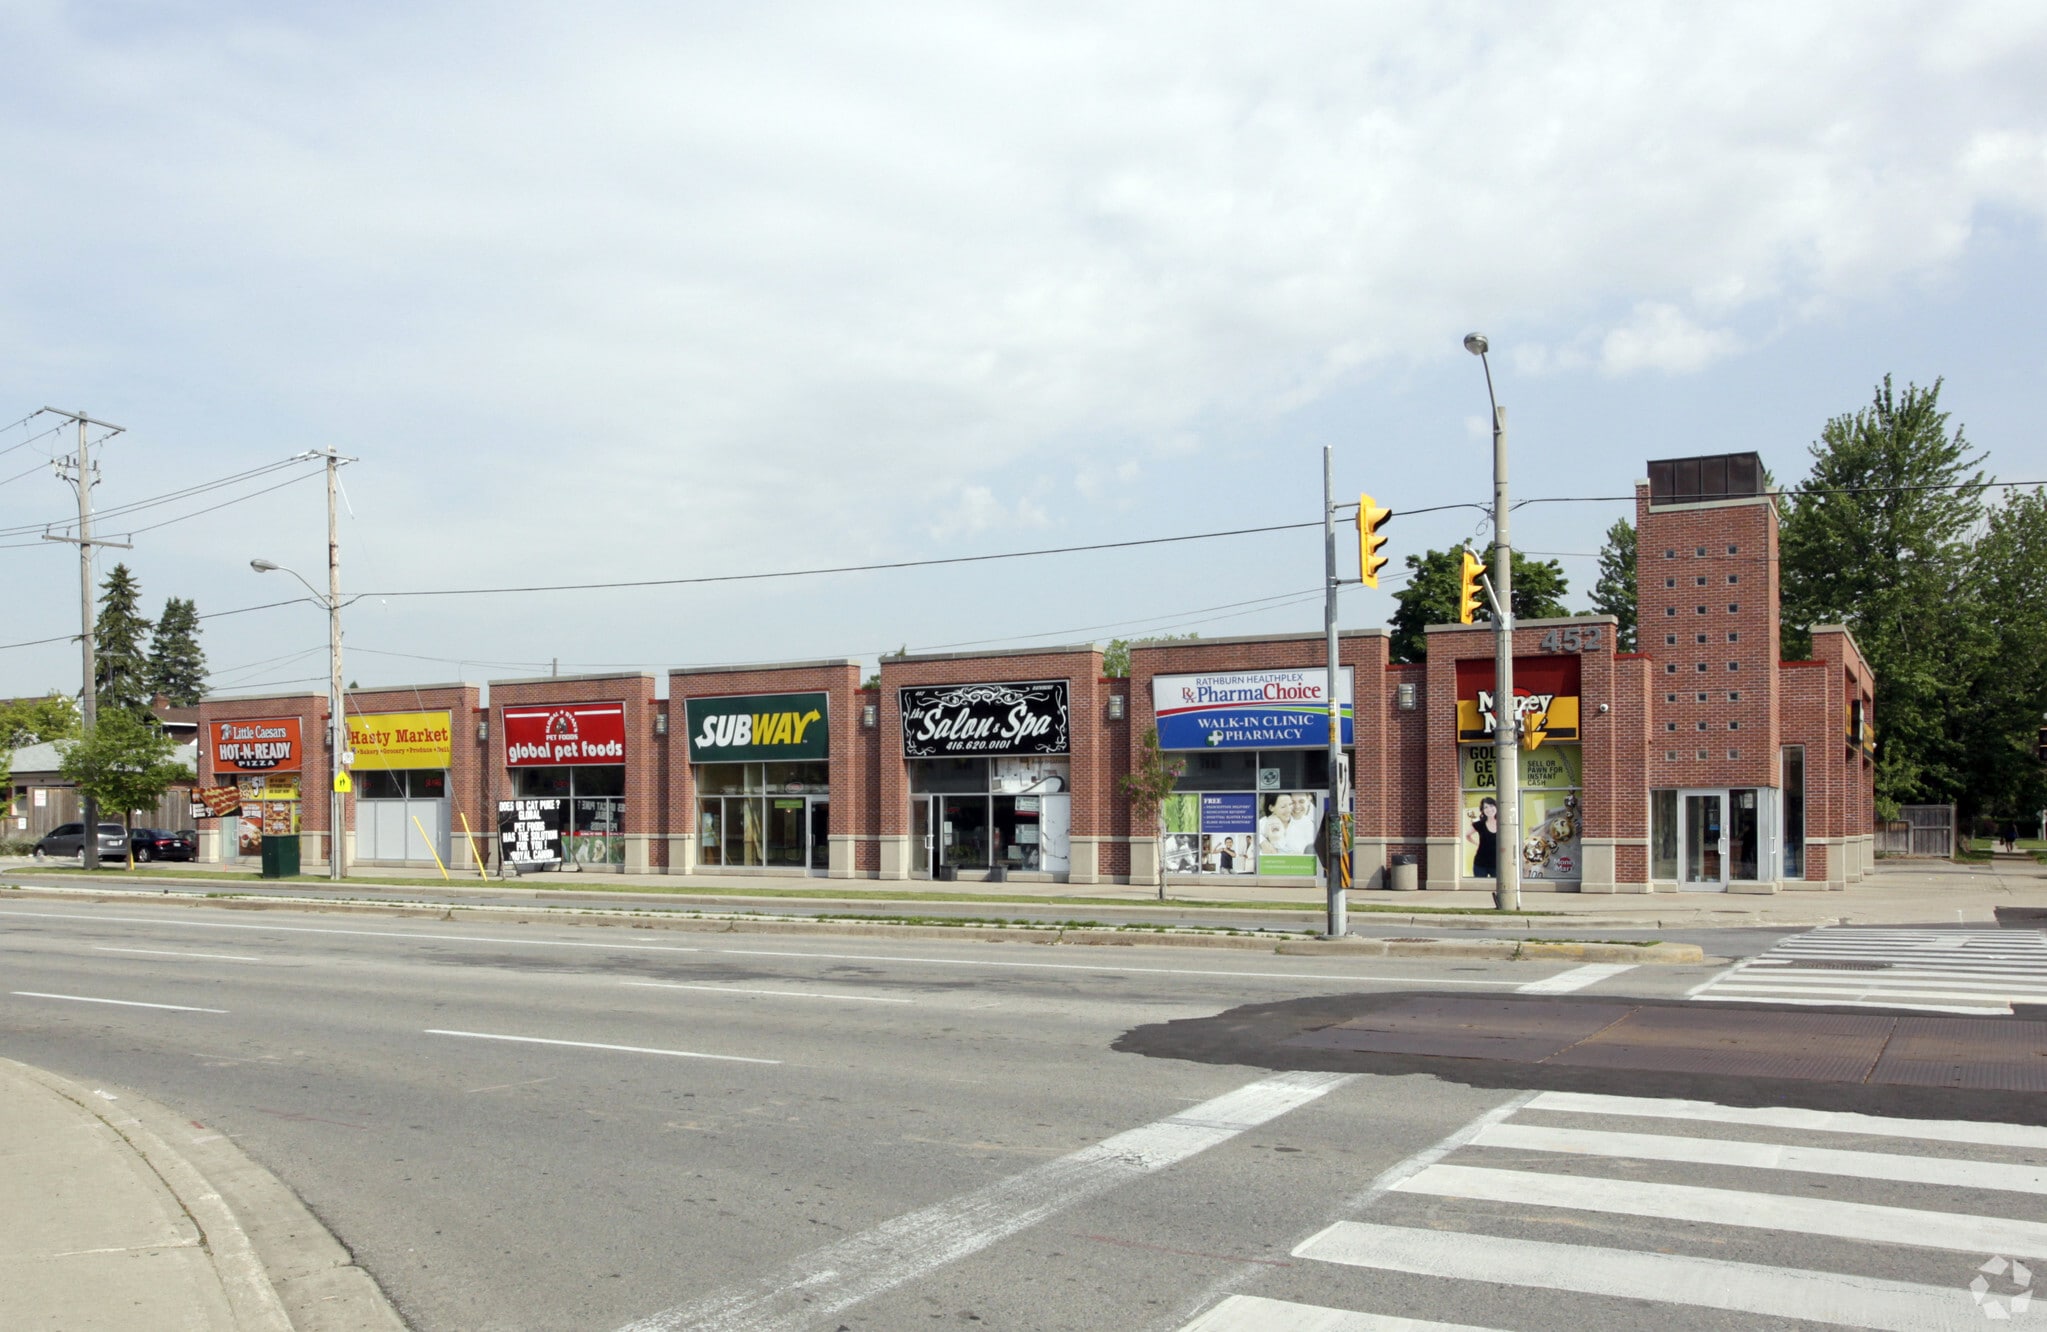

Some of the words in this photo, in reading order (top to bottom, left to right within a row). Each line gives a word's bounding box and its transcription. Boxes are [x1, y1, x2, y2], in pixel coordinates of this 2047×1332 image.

[1541, 627, 1602, 652] 452
[1196, 676, 1244, 686] RATHBURN
[1246, 673, 1303, 684] HEALTHPLEX
[1197, 682, 1321, 703] PharmaChoice
[1478, 691, 1553, 713] Mney
[910, 708, 925, 719] the
[917, 707, 995, 741] Salon
[1001, 705, 1052, 745] Spa
[1197, 717, 1259, 728] WALK-IN
[1262, 714, 1314, 726] CLINIC
[233, 726, 254, 740] Little
[255, 725, 286, 739] Caesars
[694, 708, 821, 750] SUBWAY
[1225, 728, 1303, 741] PHARMACY
[350, 730, 391, 746] Hasty
[395, 728, 448, 743] Market
[219, 742, 291, 760] HOT-N-READY
[509, 742, 551, 763] global
[554, 742, 579, 762] pet
[581, 740, 623, 757] foods
[946, 740, 1011, 750] 416.620.0101
[1469, 746, 1496, 760] GOL
[1474, 760, 1496, 773] GE
[499, 801, 514, 812] DOES
[526, 800, 539, 810] CAT
[514, 822, 526, 832] PET
[503, 832, 516, 843] HAS
[518, 832, 529, 842] THE
[516, 841, 528, 851] FOR
